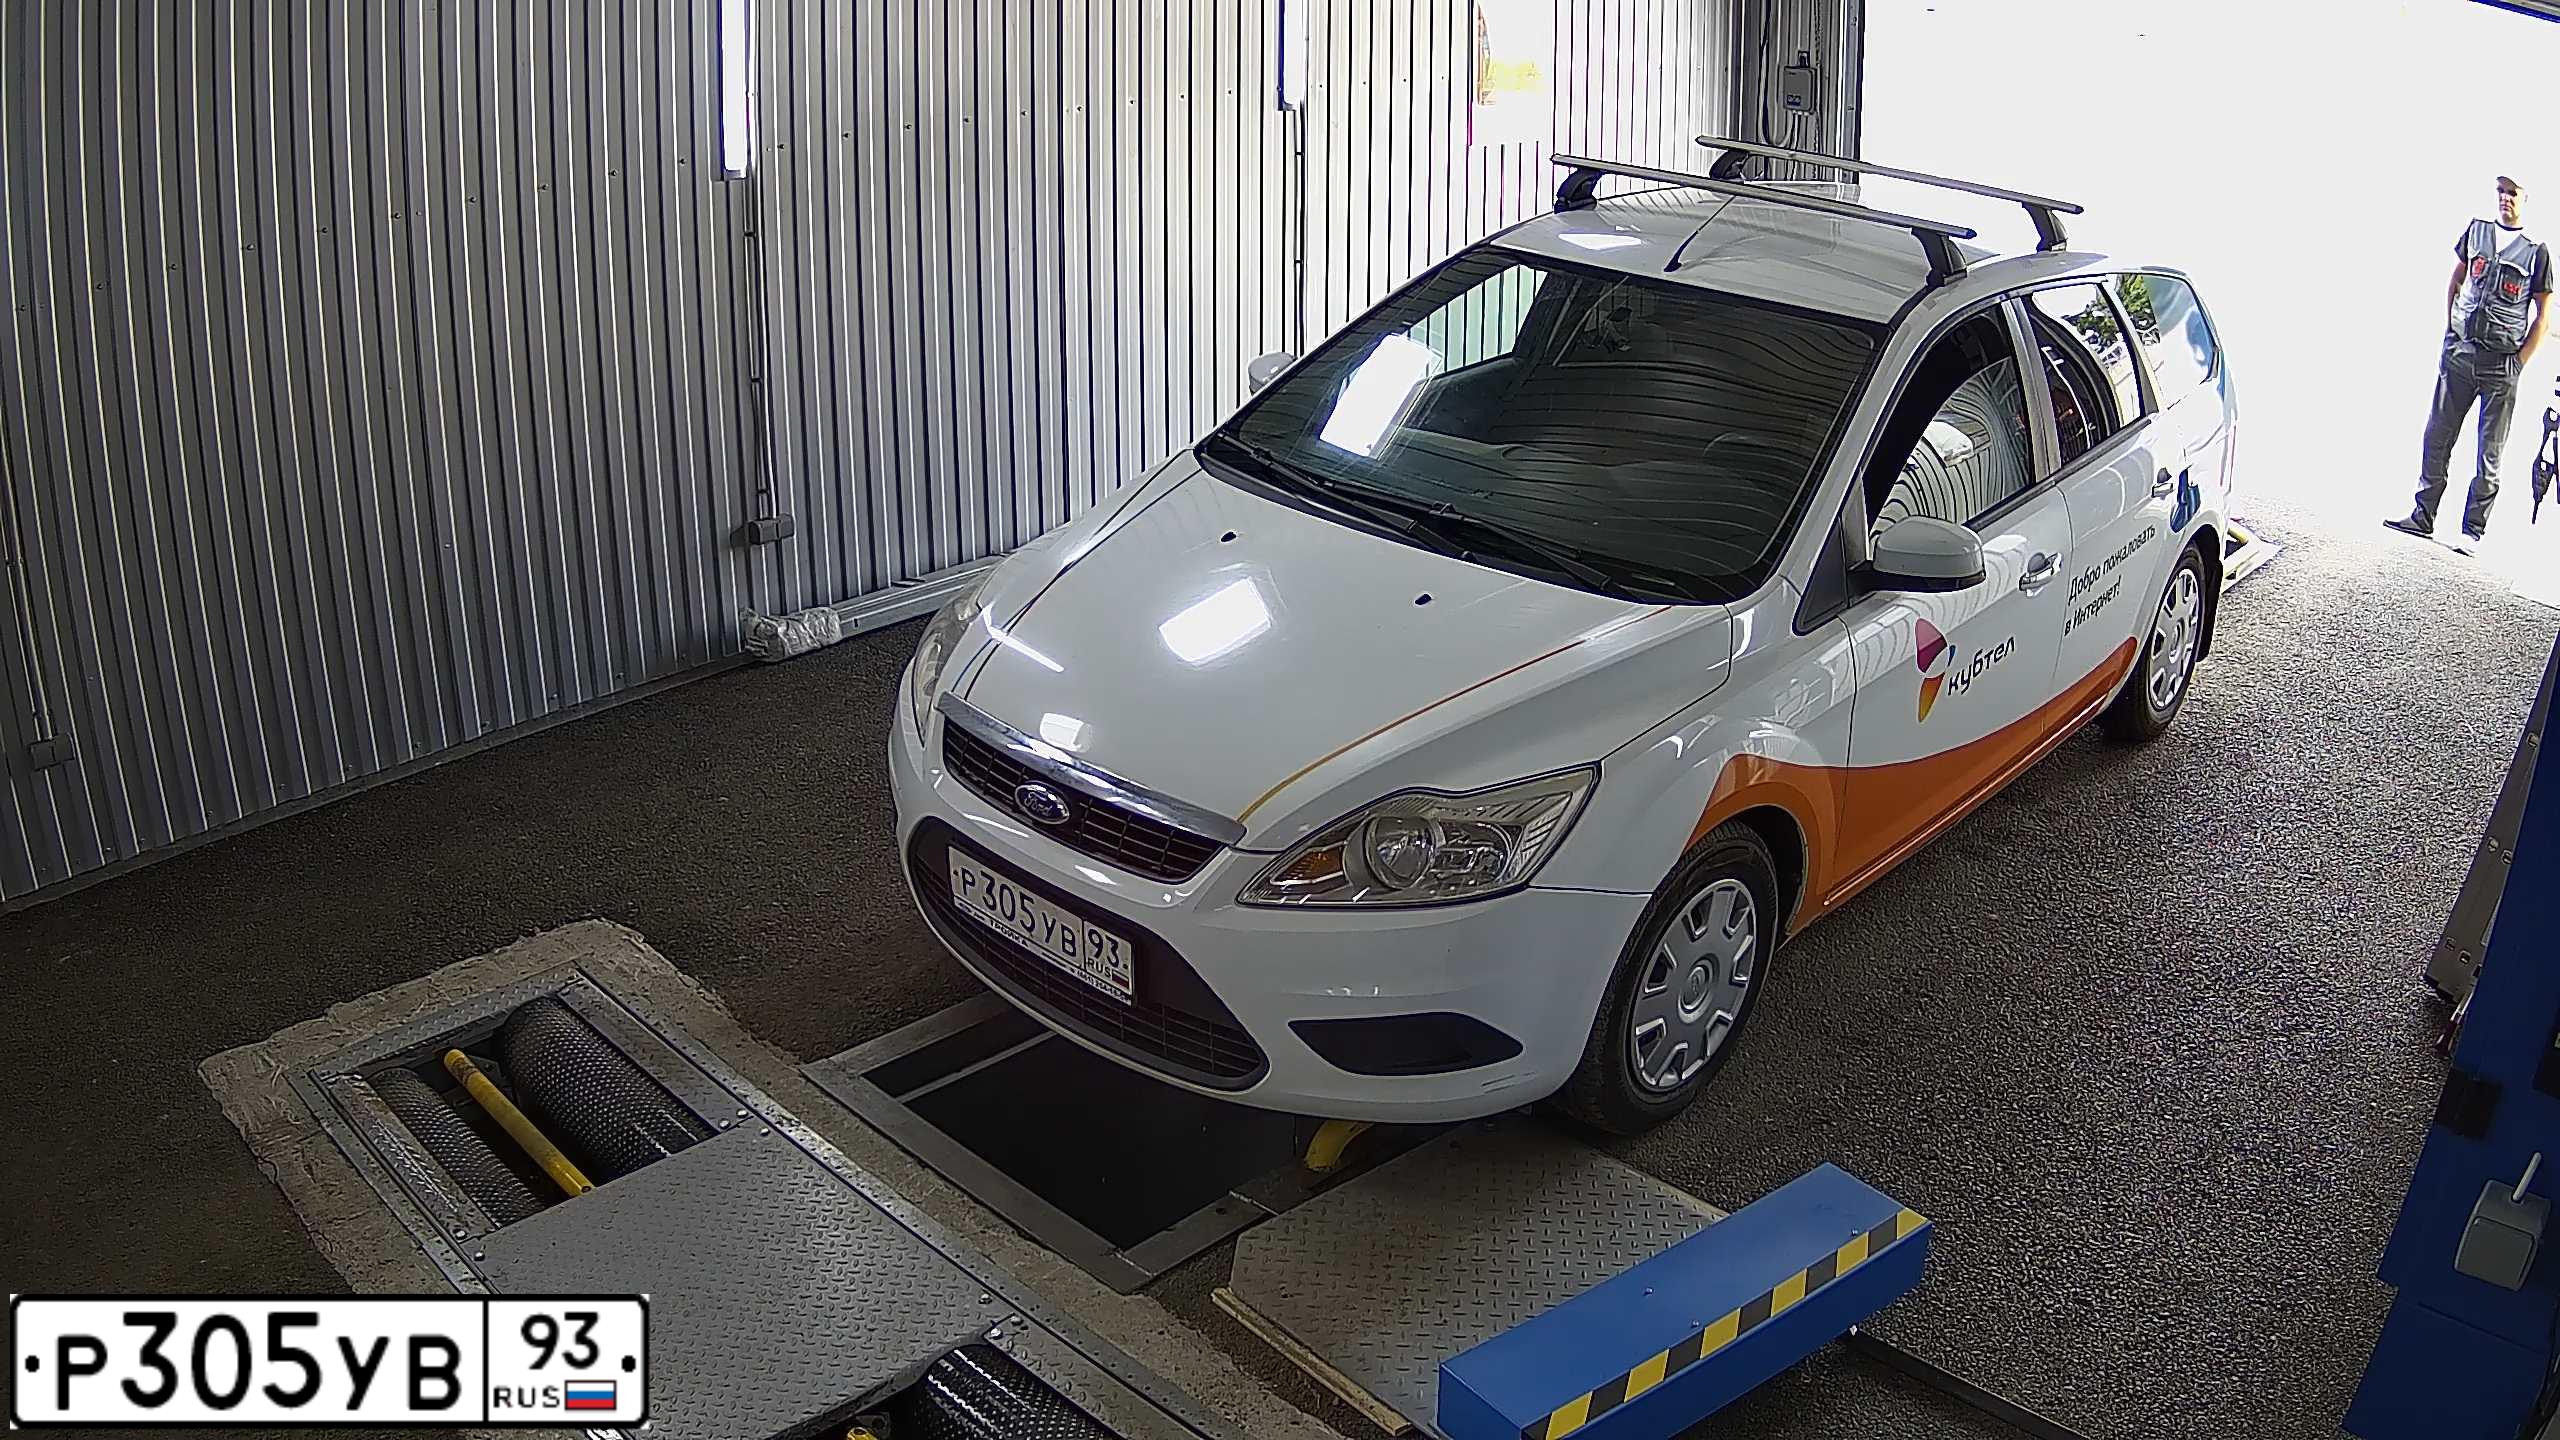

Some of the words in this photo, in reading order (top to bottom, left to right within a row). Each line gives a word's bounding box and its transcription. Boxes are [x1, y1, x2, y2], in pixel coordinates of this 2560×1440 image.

[2068, 566, 2101, 606] Добро
[2103, 524, 2156, 575] пожаловать
[2064, 619, 2072, 637] в
[2073, 574, 2122, 629] Интернет!
[1947, 635, 2015, 696] кубтел
[961, 867, 1077, 958] Р305УВ
[1088, 928, 1119, 968] 93
[1087, 957, 1112, 978] RUS
